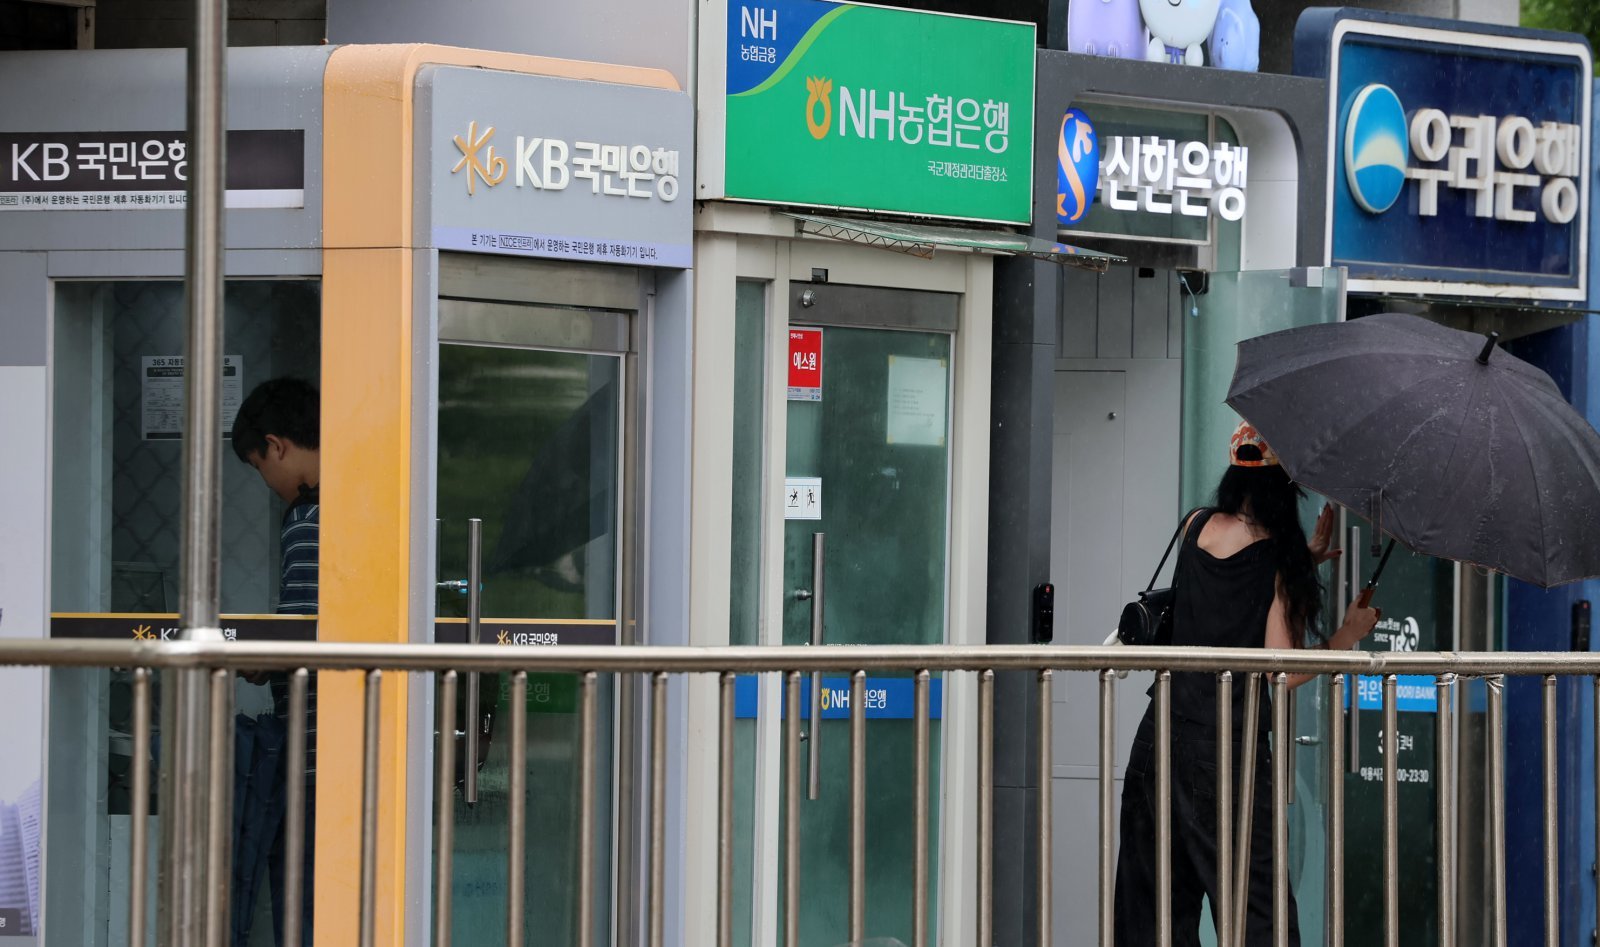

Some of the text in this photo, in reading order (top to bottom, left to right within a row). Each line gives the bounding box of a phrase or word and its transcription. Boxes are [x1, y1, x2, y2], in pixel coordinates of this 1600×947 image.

[741, 5, 777, 41] NH
[741, 43, 777, 64] 농협금융
[1404, 108, 1581, 224] 우리은행
[1105, 135, 1248, 222] 신한은행
[51, 195, 80, 205] 운영하는
[82, 195, 111, 205] 국민은행
[113, 195, 127, 204] 제휴
[547, 239, 570, 253] 운영하는
[572, 241, 595, 255] 국민은행
[793, 352, 817, 371] 에스원
